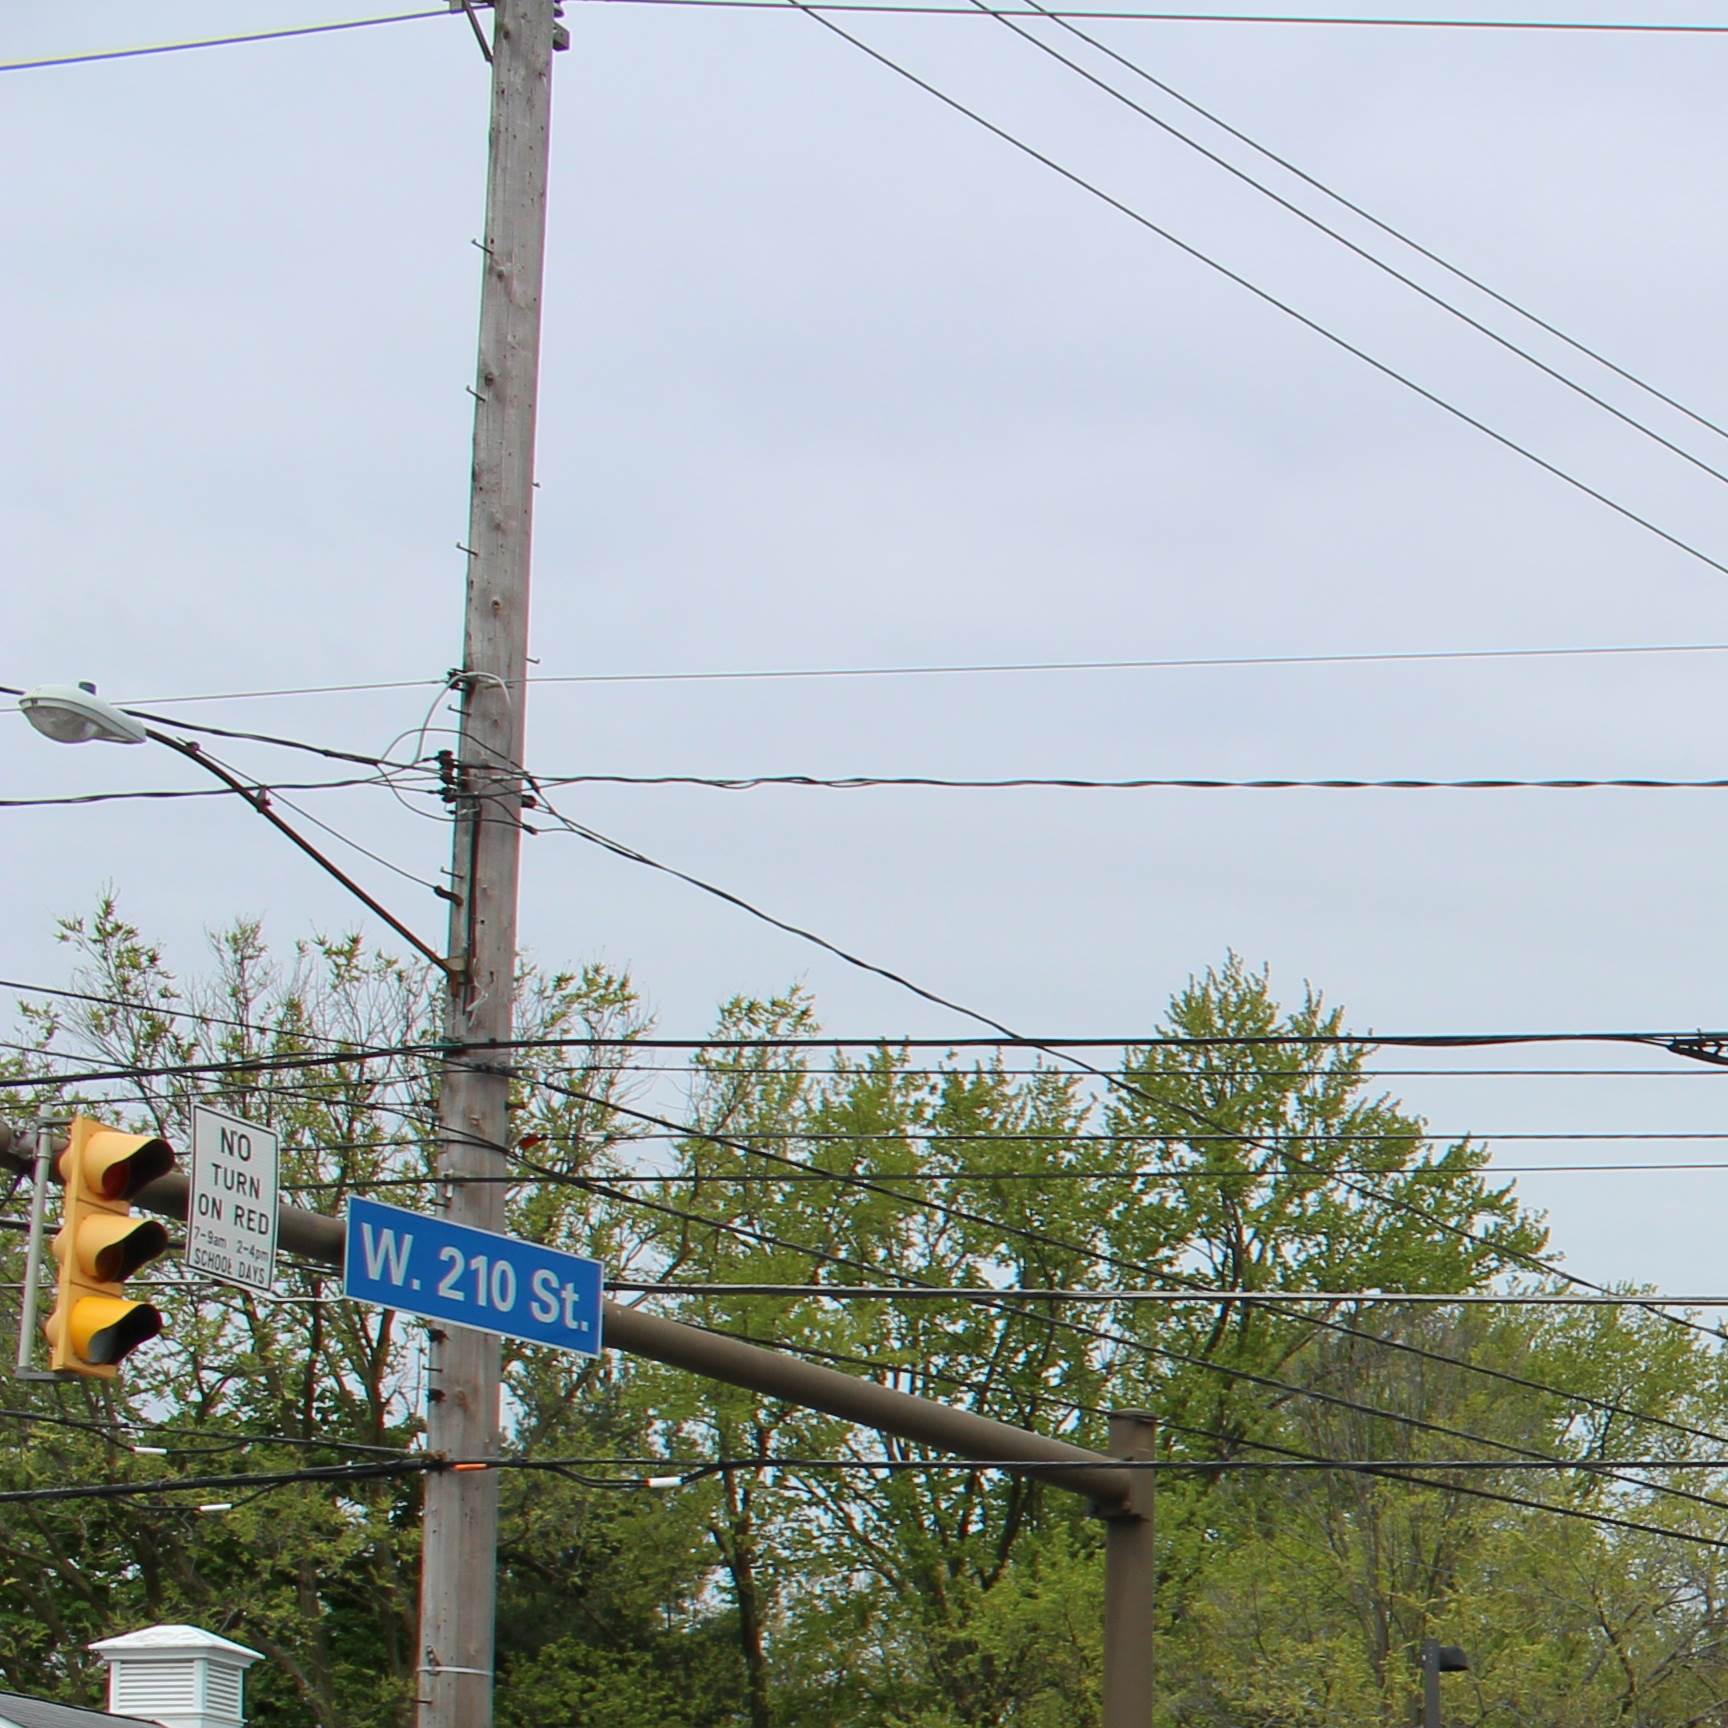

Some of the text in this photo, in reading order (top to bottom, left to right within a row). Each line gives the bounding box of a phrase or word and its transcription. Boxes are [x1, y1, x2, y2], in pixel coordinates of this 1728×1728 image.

[220, 1126, 251, 1162] NO
[211, 1162, 260, 1200] TURN
[198, 1193, 269, 1235] ON RED
[194, 1226, 269, 1263] 7-9am 2-4pm
[194, 1248, 265, 1285] SCHOOL DAYS
[361, 1222, 589, 1332] W. 210 St.
